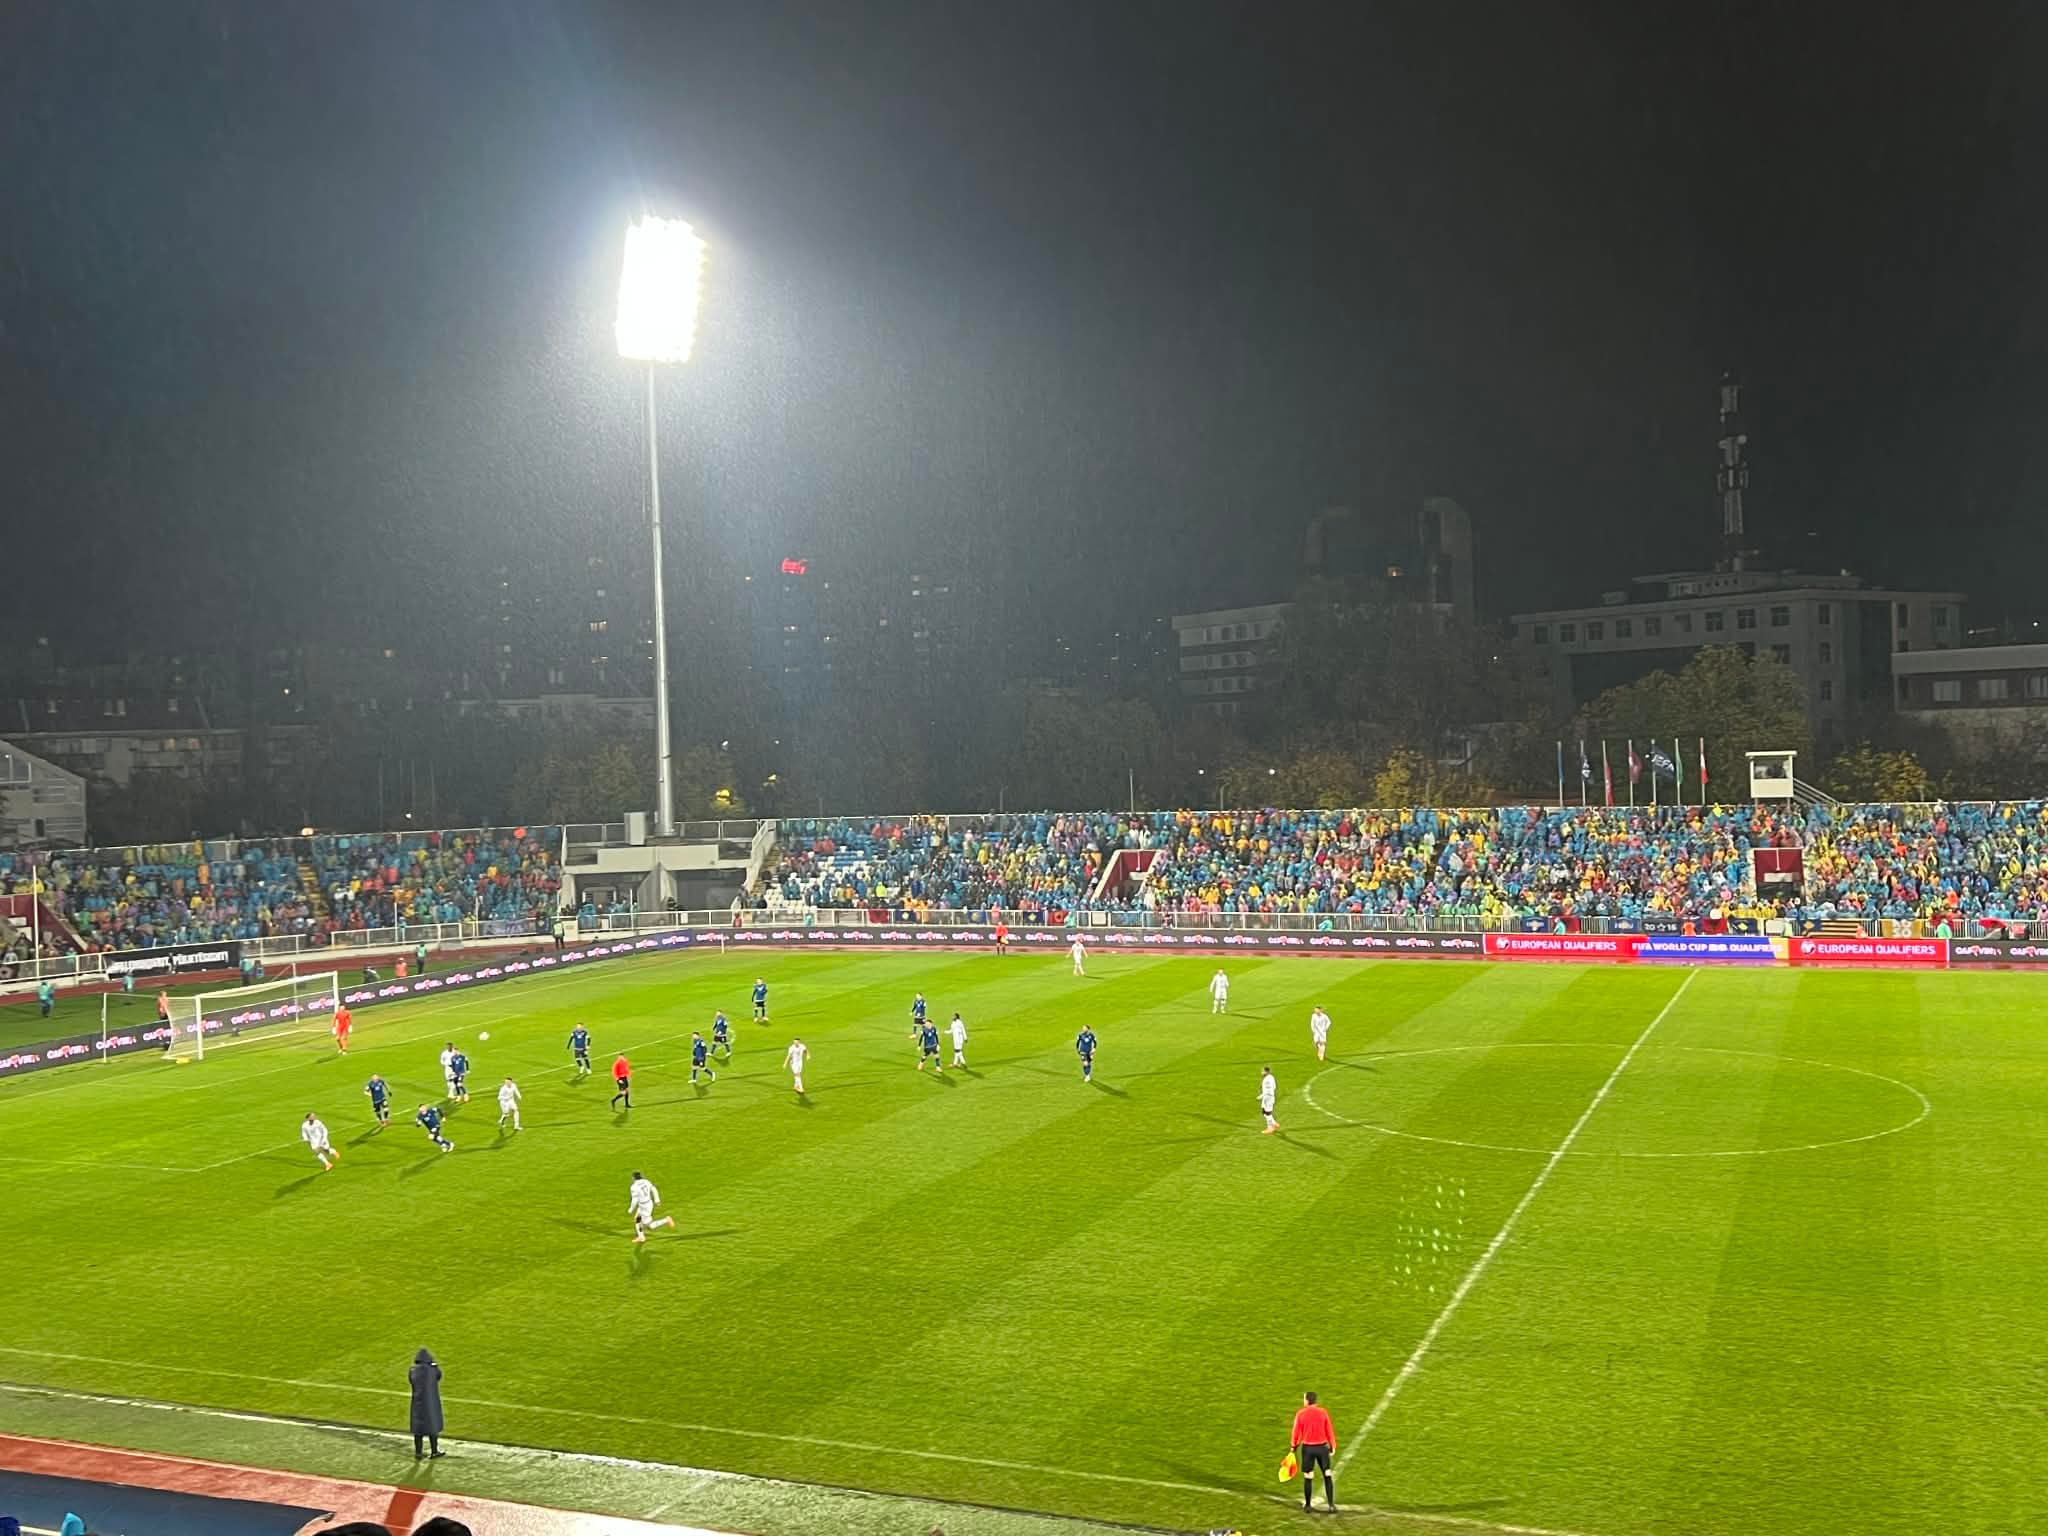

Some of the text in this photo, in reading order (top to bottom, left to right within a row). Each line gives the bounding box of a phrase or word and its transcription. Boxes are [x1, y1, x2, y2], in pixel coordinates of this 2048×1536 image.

[1511, 940, 1617, 951] EUROPEAN QUALIFIERS
[1631, 942, 1653, 951] FIFA
[1653, 943, 1687, 951] WORLD
[1688, 943, 1707, 952] CUP
[1817, 943, 1937, 955] EUROPEAN QUALIFIERS
